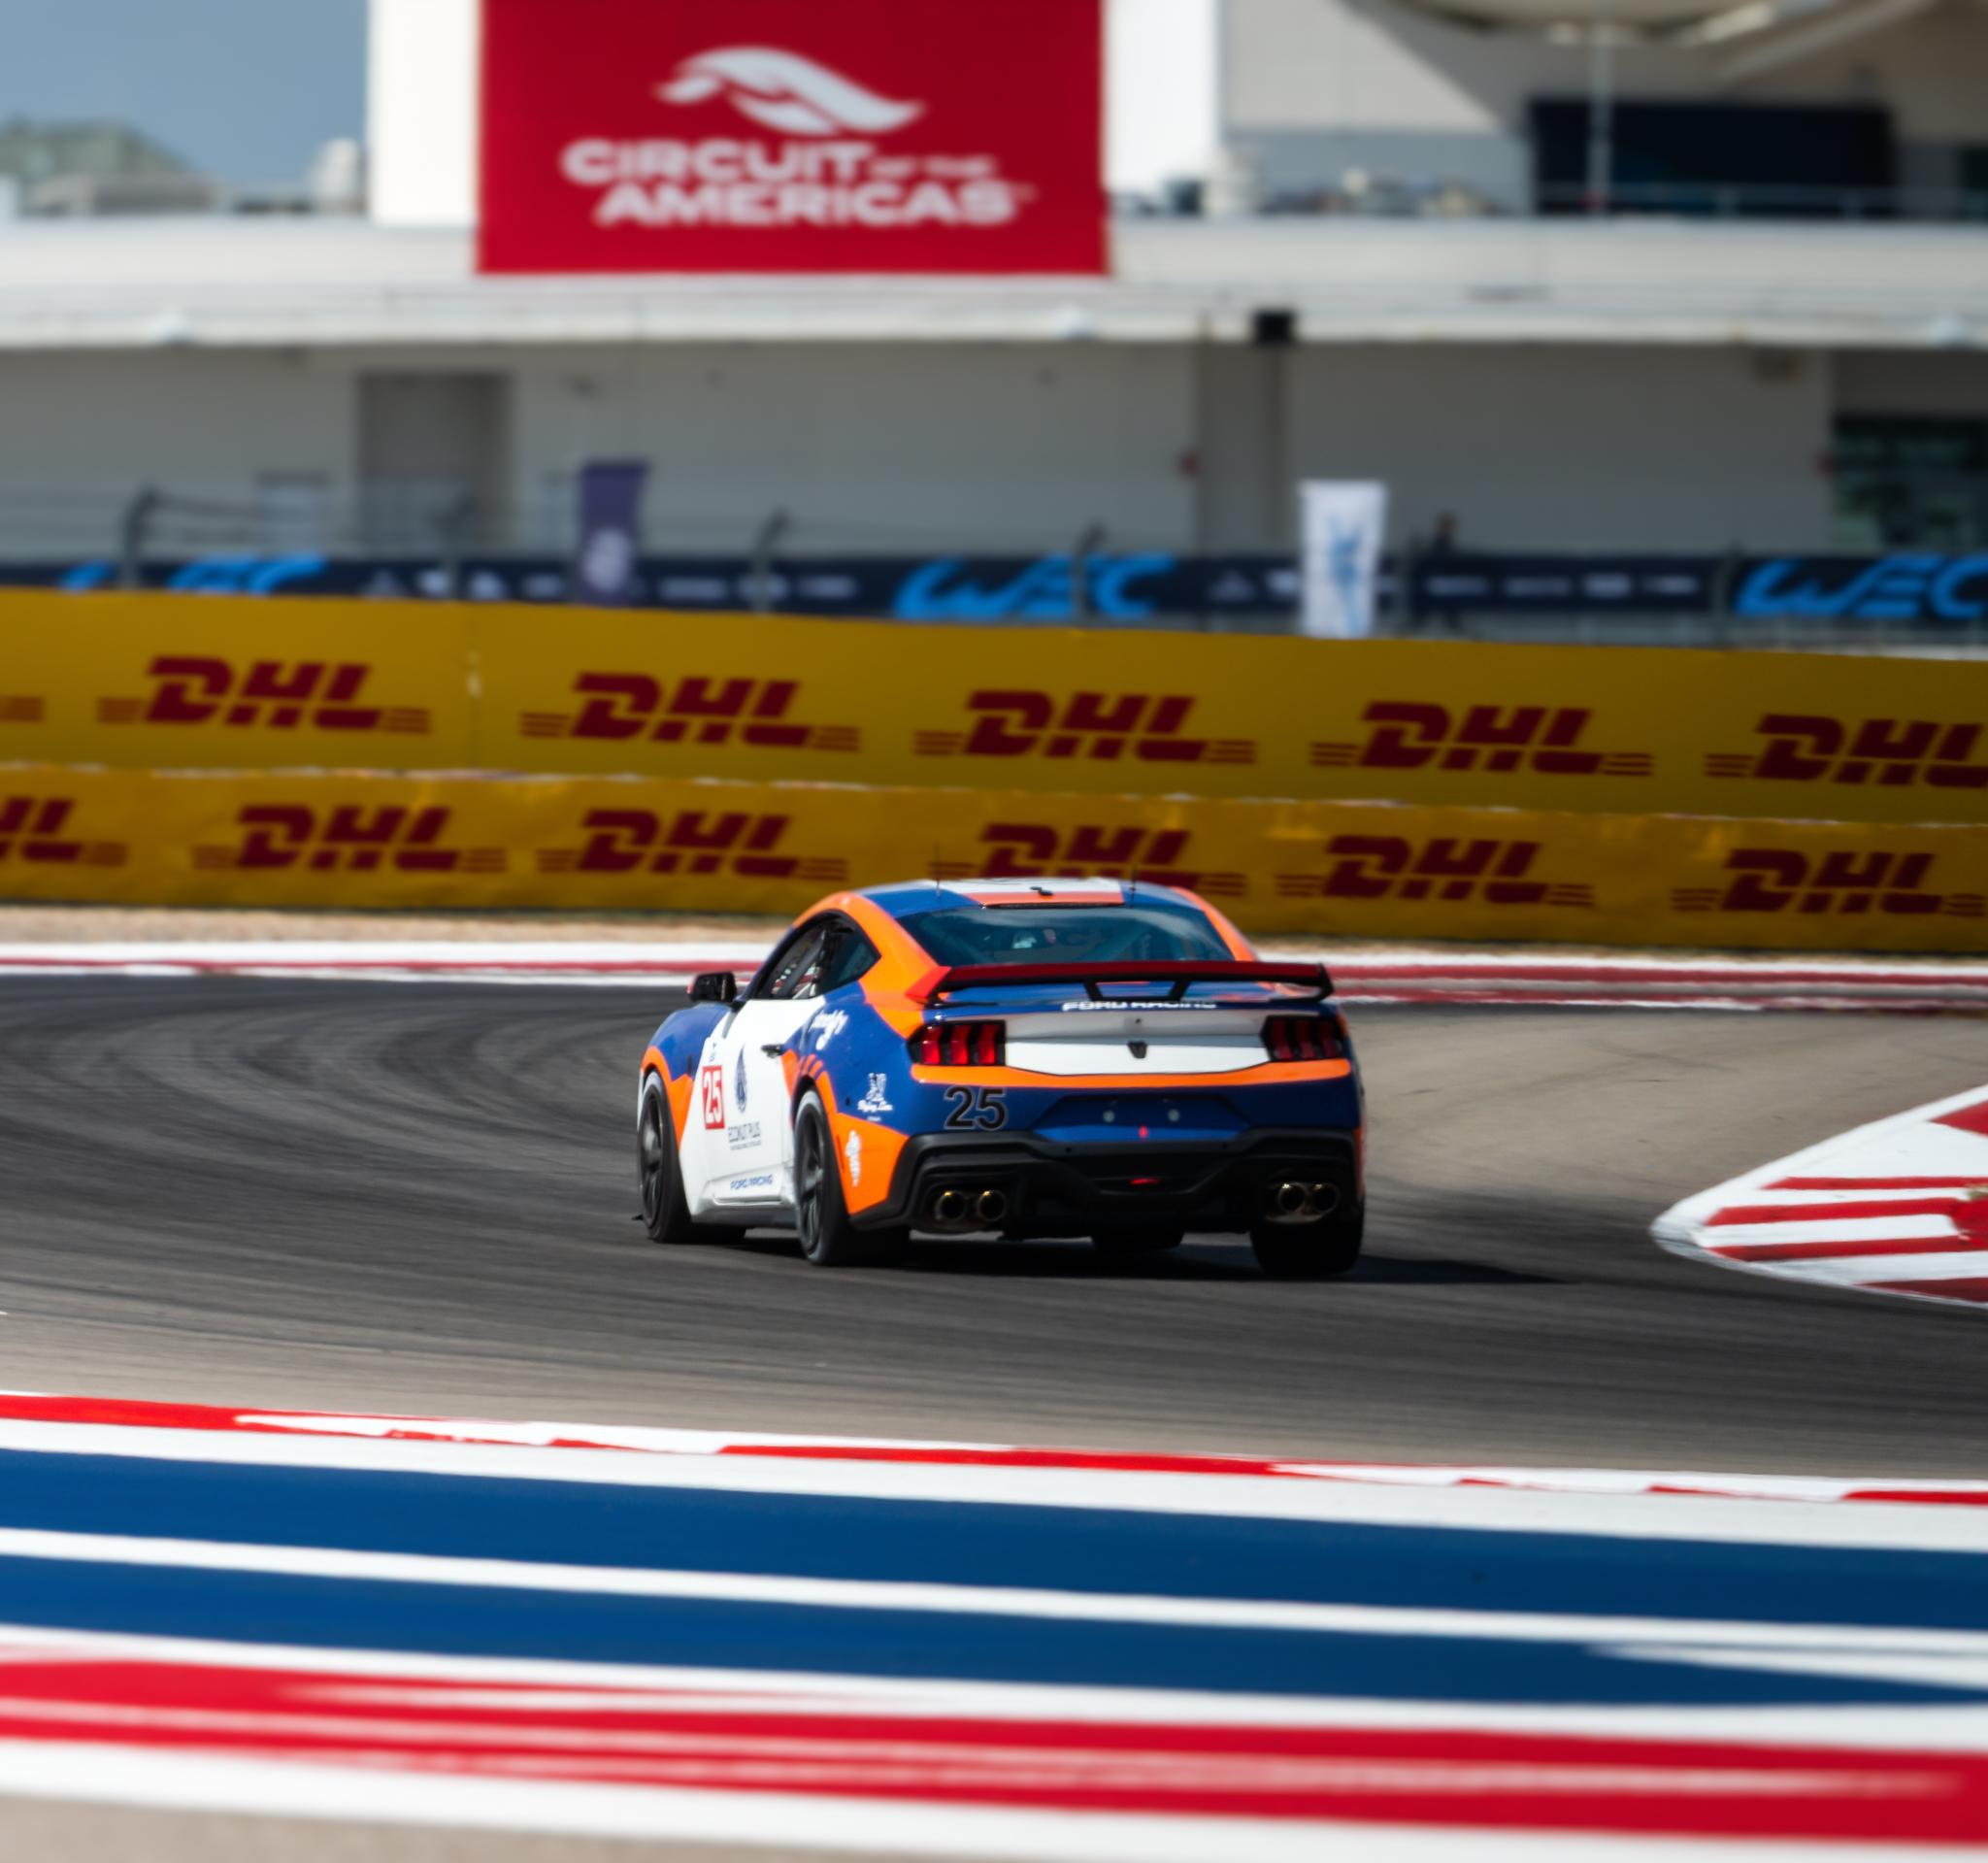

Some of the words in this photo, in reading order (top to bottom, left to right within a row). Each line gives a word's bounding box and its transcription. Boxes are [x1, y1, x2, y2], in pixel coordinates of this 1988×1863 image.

[560, 137, 877, 185] CIRCUIT
[592, 181, 1018, 227] AMERICAS
[890, 552, 1176, 621] WEC
[1734, 553, 1988, 619] WEC
[145, 656, 382, 731] DHL
[571, 673, 812, 748] DHL
[962, 690, 1209, 763] DHL
[1359, 701, 1605, 776] DHL
[1752, 713, 1988, 789] DHL
[233, 806, 462, 873] DHL
[577, 809, 803, 880] DHL
[979, 823, 1202, 896] DHL
[1322, 834, 1547, 905] DHL
[1718, 848, 1943, 915] DHL
[703, 1069, 722, 1124] 25
[944, 1085, 1008, 1131] 25
